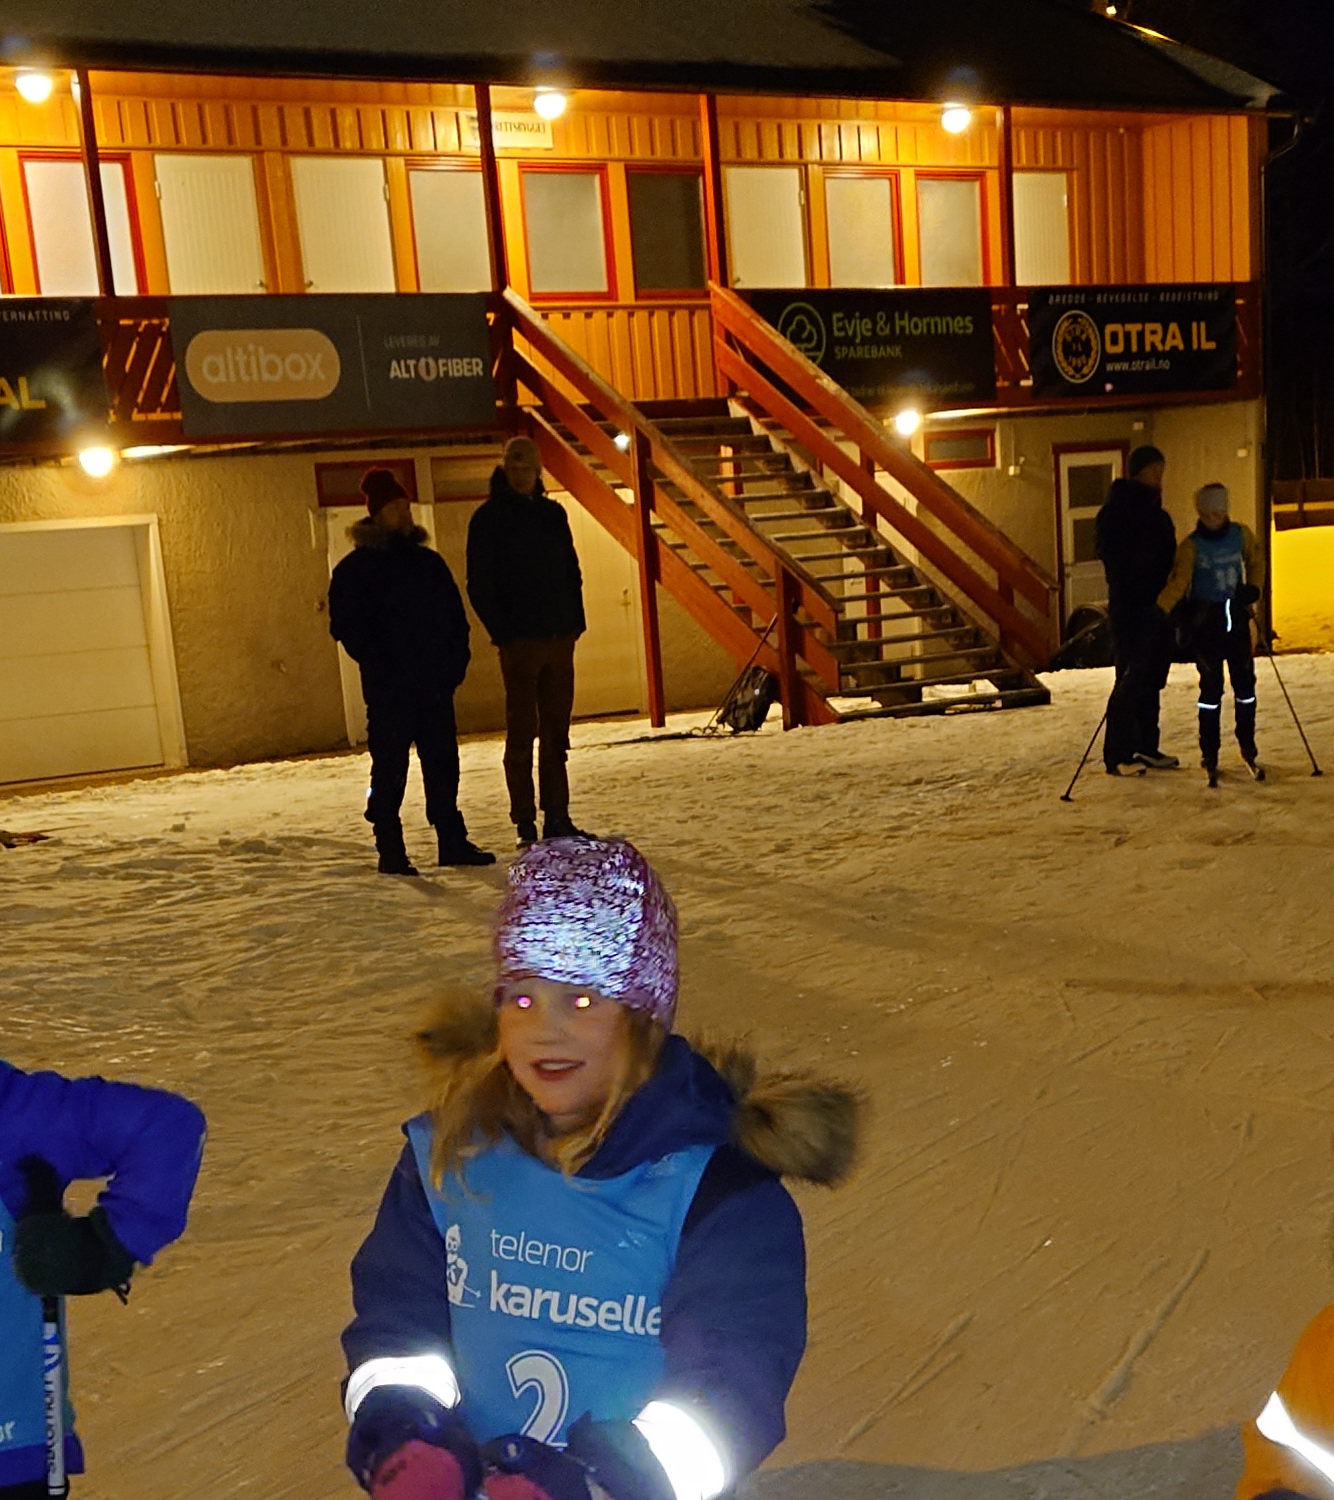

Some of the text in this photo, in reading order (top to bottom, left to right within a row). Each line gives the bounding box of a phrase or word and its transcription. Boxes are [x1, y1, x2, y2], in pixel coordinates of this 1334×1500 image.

[832, 311, 974, 343] Evje & Hornnes
[1104, 321, 1217, 354] OTRA IL
[202, 343, 327, 383] altibox
[834, 346, 903, 360] SPAREBANK
[1105, 358, 1170, 372] www.otrail.no
[490, 1229, 593, 1273] telenor
[490, 1270, 662, 1335] karuselle
[506, 1350, 569, 1447] 2
